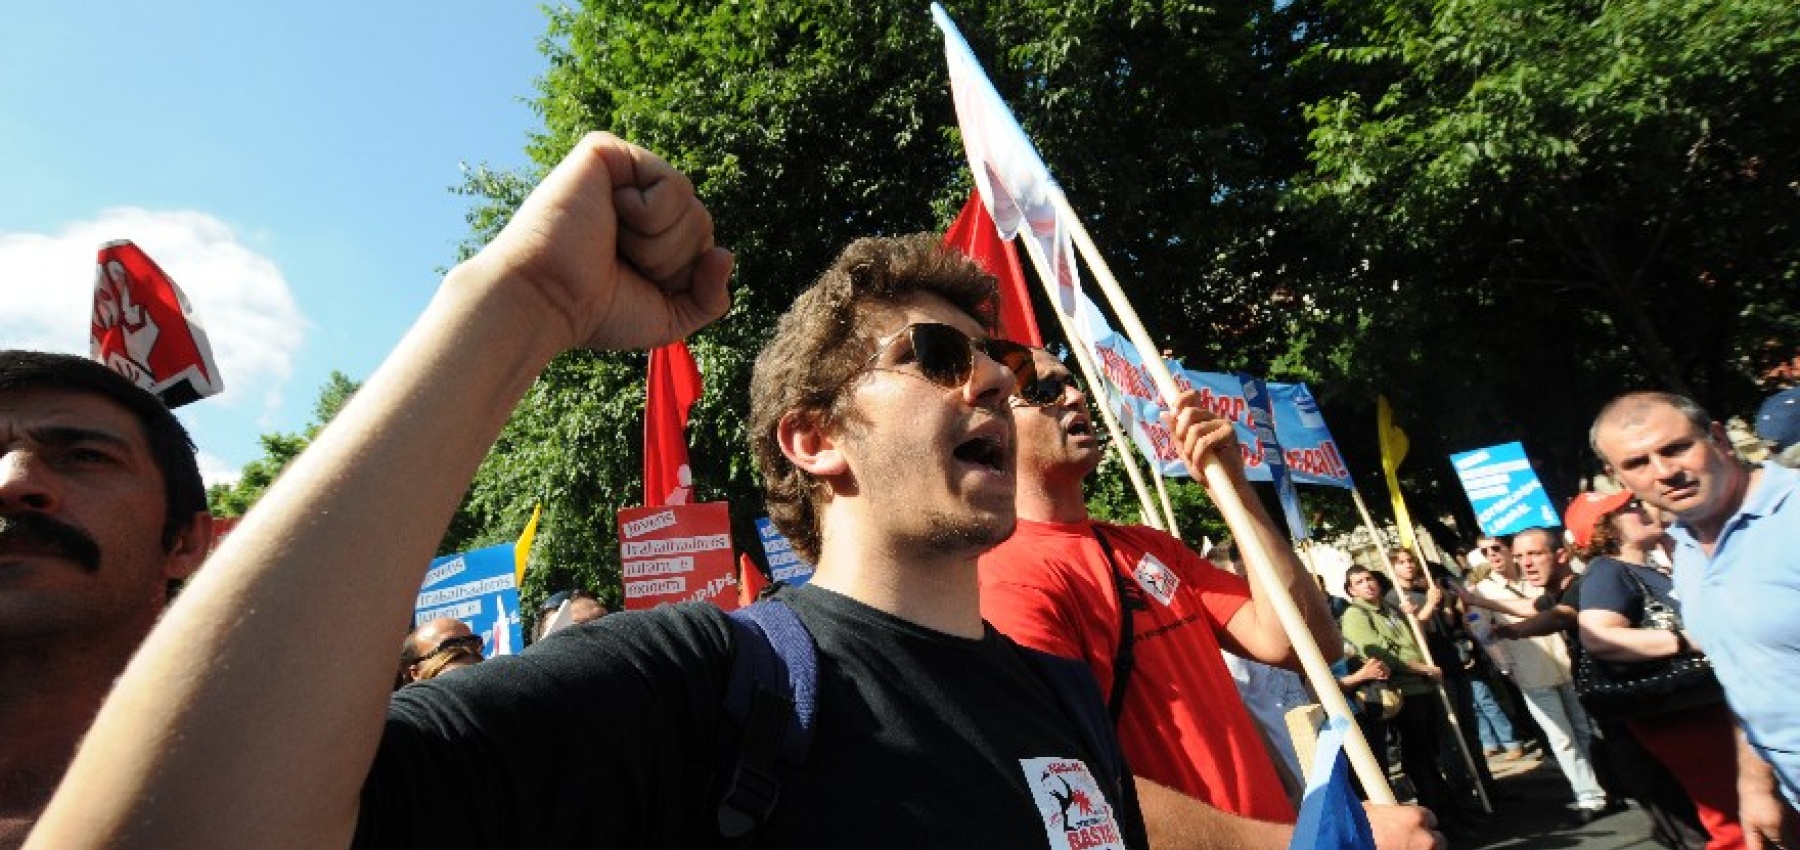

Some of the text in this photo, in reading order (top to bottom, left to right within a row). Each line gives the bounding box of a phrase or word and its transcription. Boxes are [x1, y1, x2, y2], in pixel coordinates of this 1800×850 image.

[626, 537, 725, 555] trabalhadores
[420, 577, 510, 606] trabalhadores
[628, 580, 680, 595] exigem
